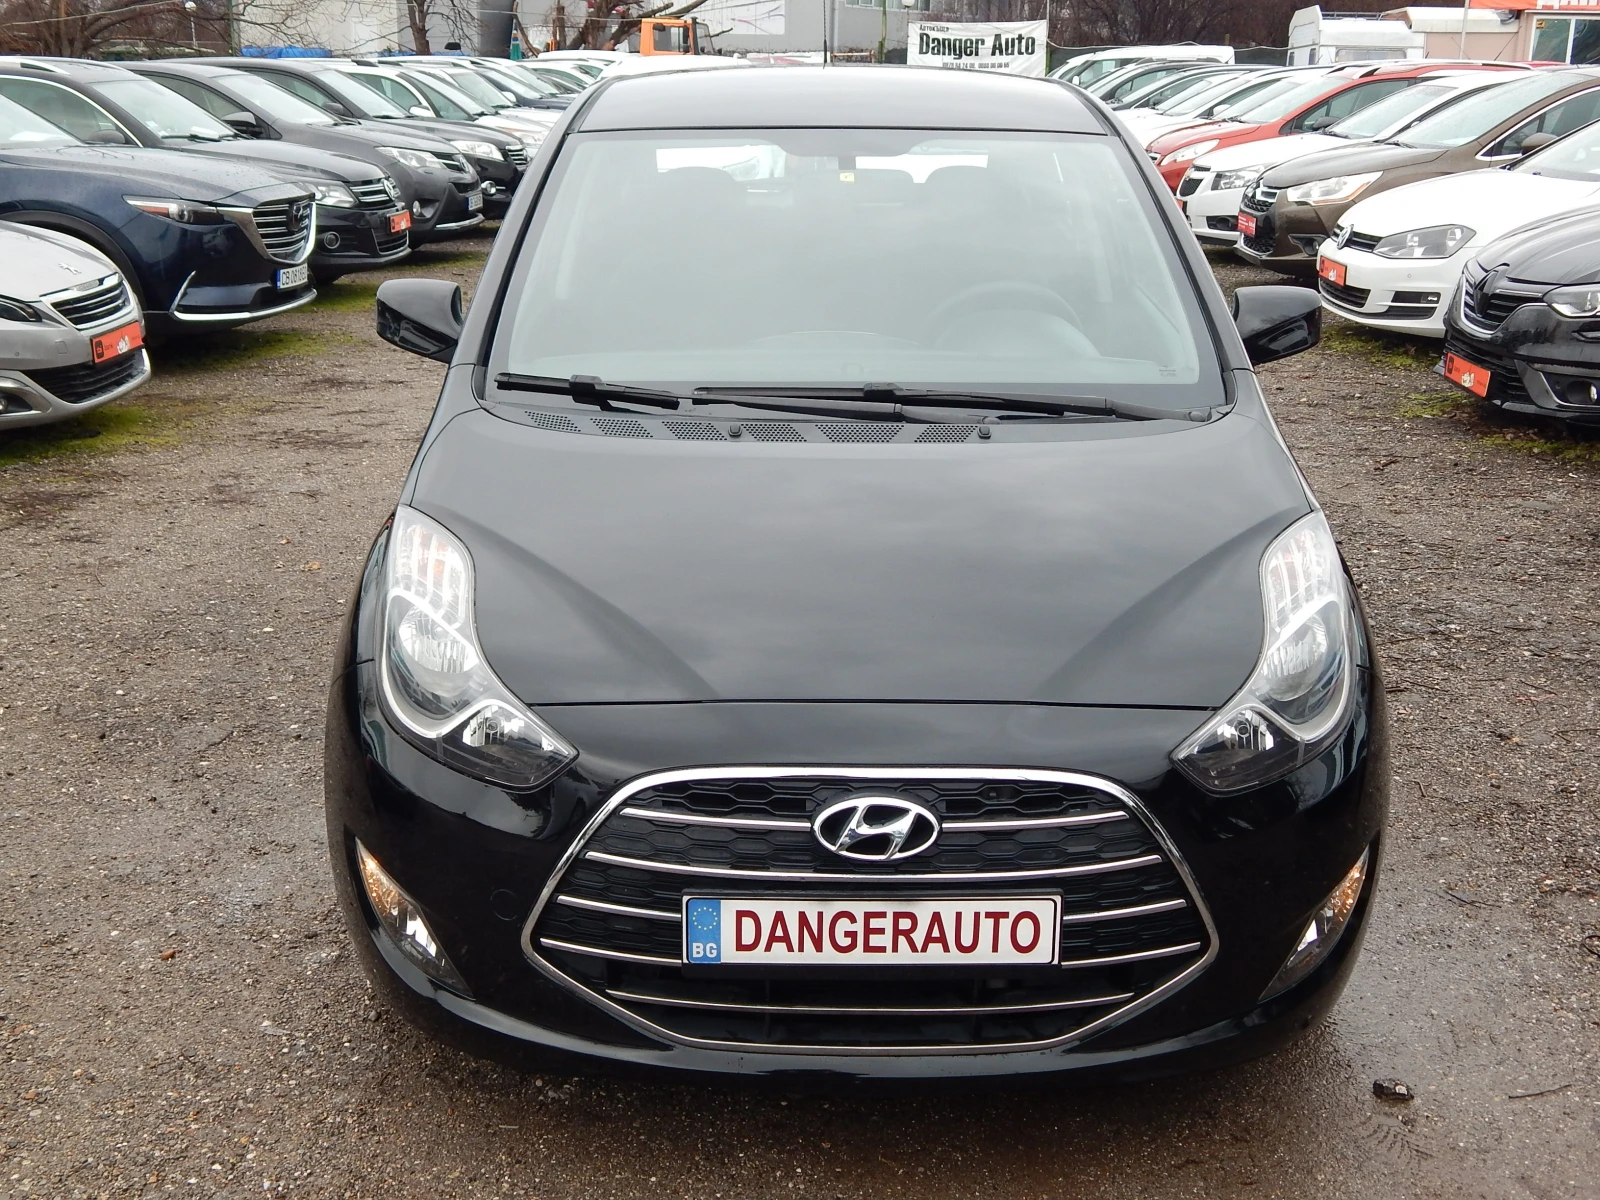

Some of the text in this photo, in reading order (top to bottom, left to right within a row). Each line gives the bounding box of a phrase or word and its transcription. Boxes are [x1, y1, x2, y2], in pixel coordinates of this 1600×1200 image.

[918, 32, 1036, 60] Danger Auto
[692, 910, 1042, 959] BG DANGERAUTO
